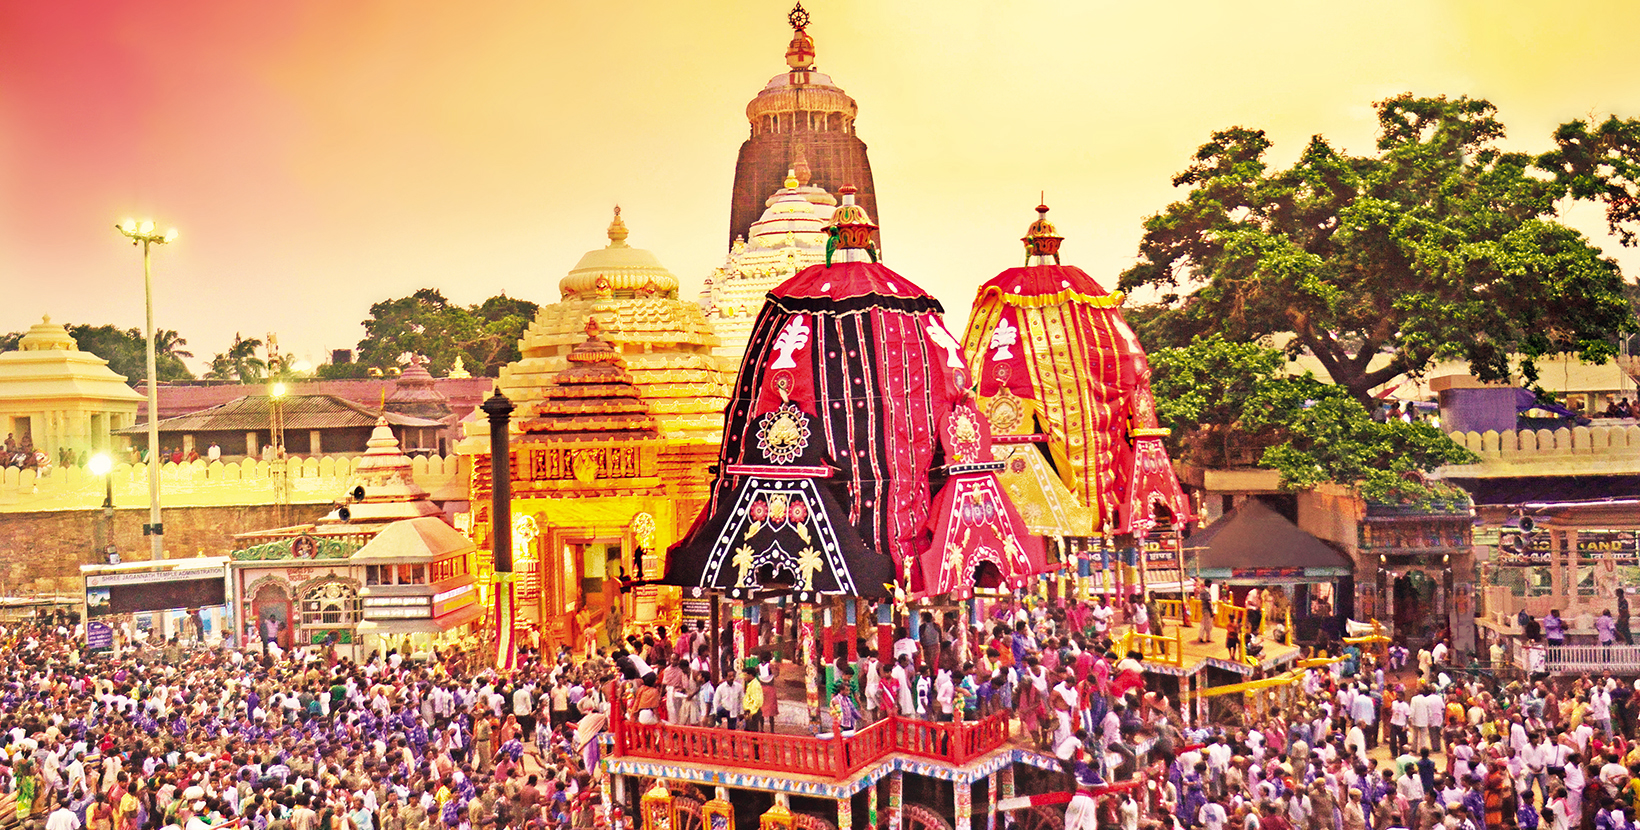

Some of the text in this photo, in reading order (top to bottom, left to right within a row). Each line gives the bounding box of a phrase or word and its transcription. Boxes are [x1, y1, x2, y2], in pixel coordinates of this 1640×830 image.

[122, 572, 155, 580] JAGANNATH
[156, 570, 177, 578] TEMPLE
[179, 568, 222, 576] ADMINISTRATION
